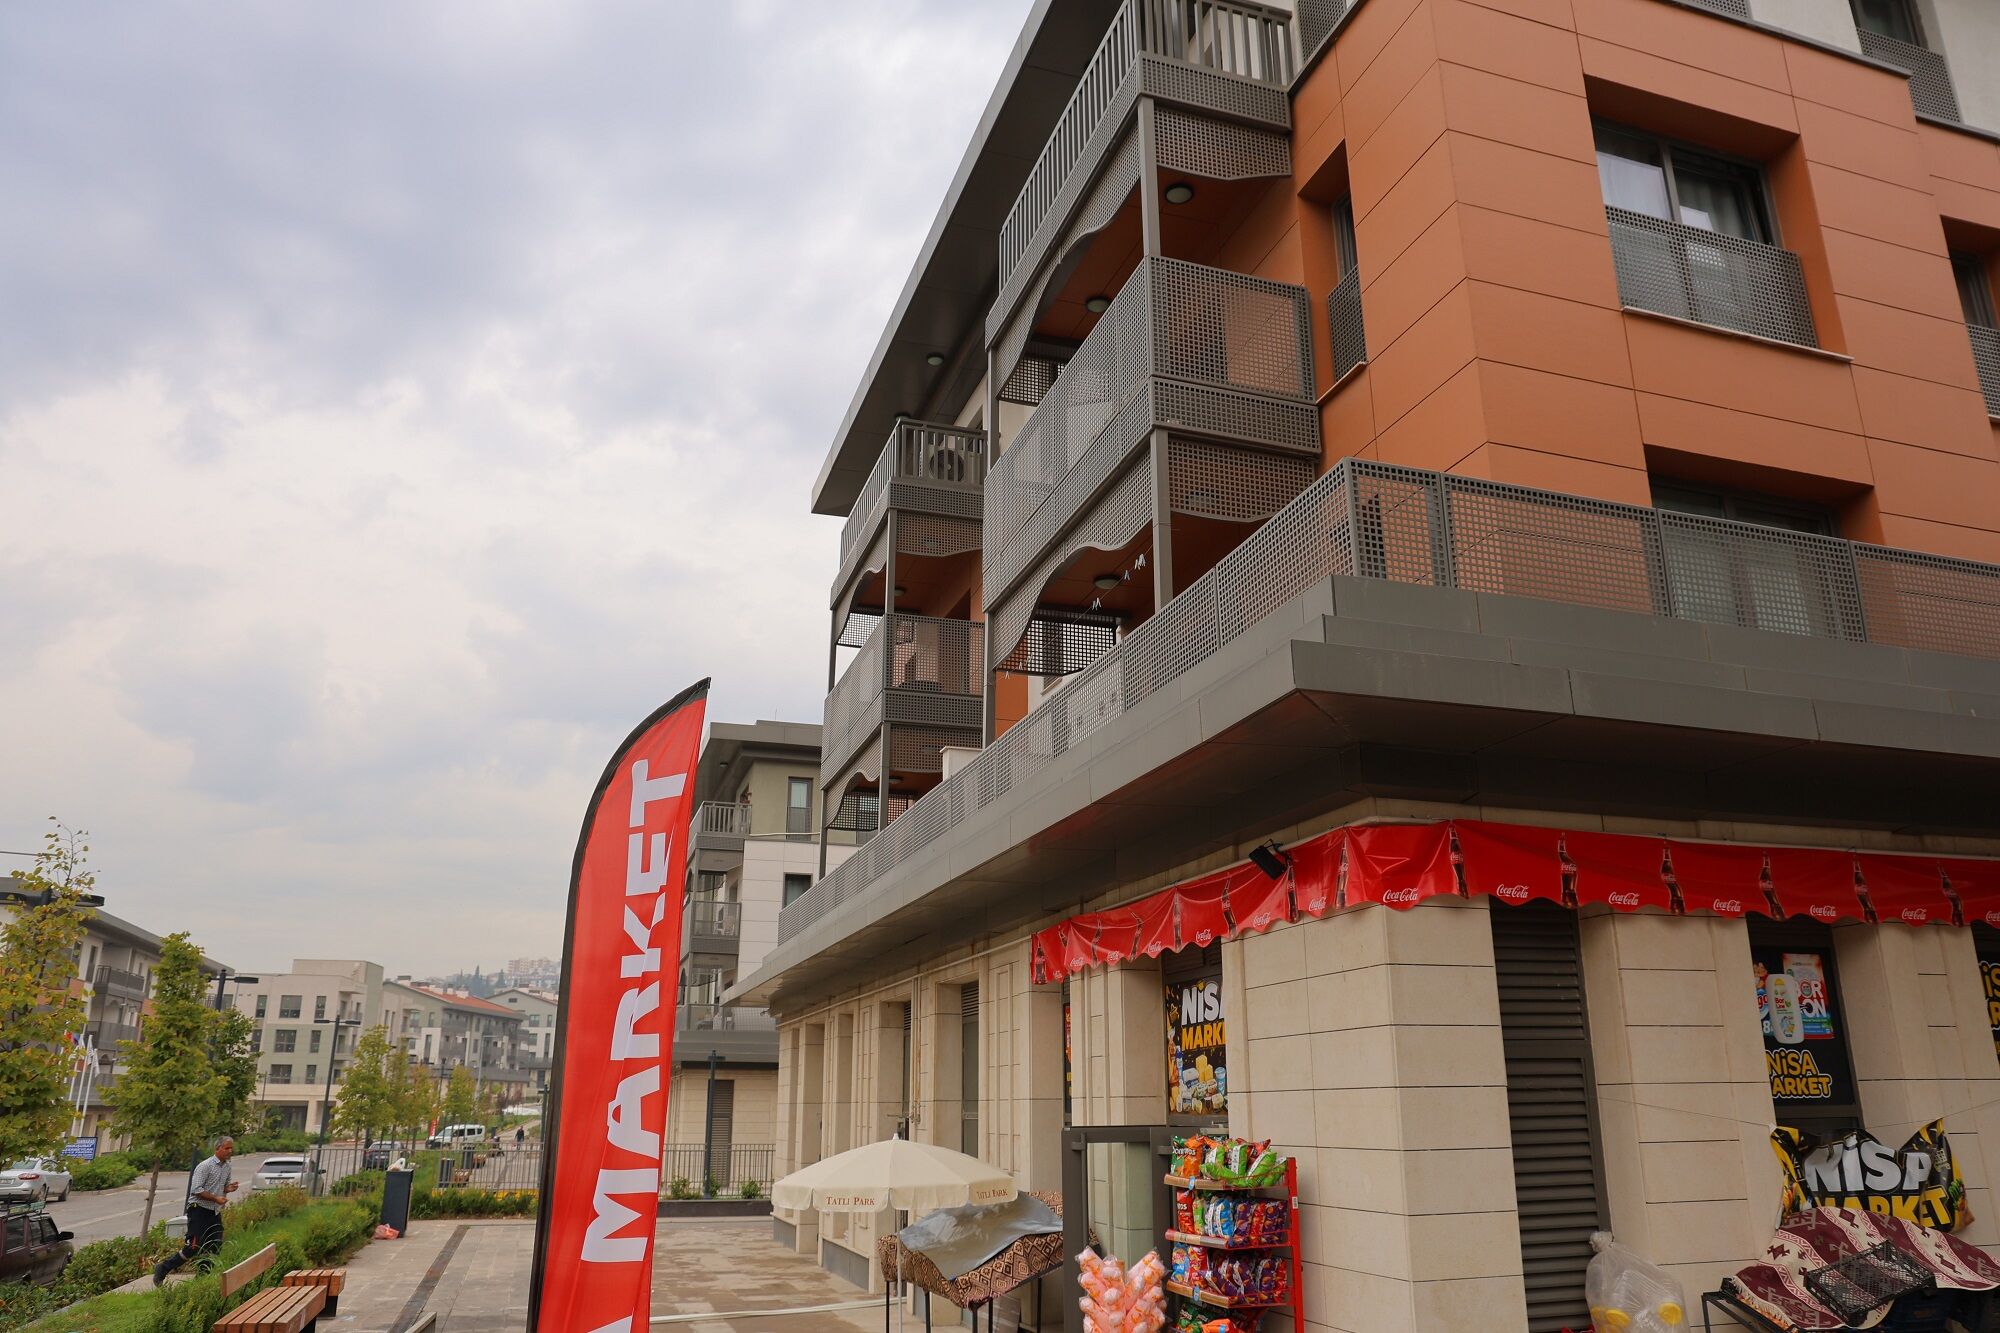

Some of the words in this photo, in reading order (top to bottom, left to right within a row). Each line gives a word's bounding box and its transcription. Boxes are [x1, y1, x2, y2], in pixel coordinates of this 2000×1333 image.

[581, 759, 687, 1263] MARKET
[1771, 1075, 1831, 1097] ARKET
[853, 1196, 875, 1206] PARK
